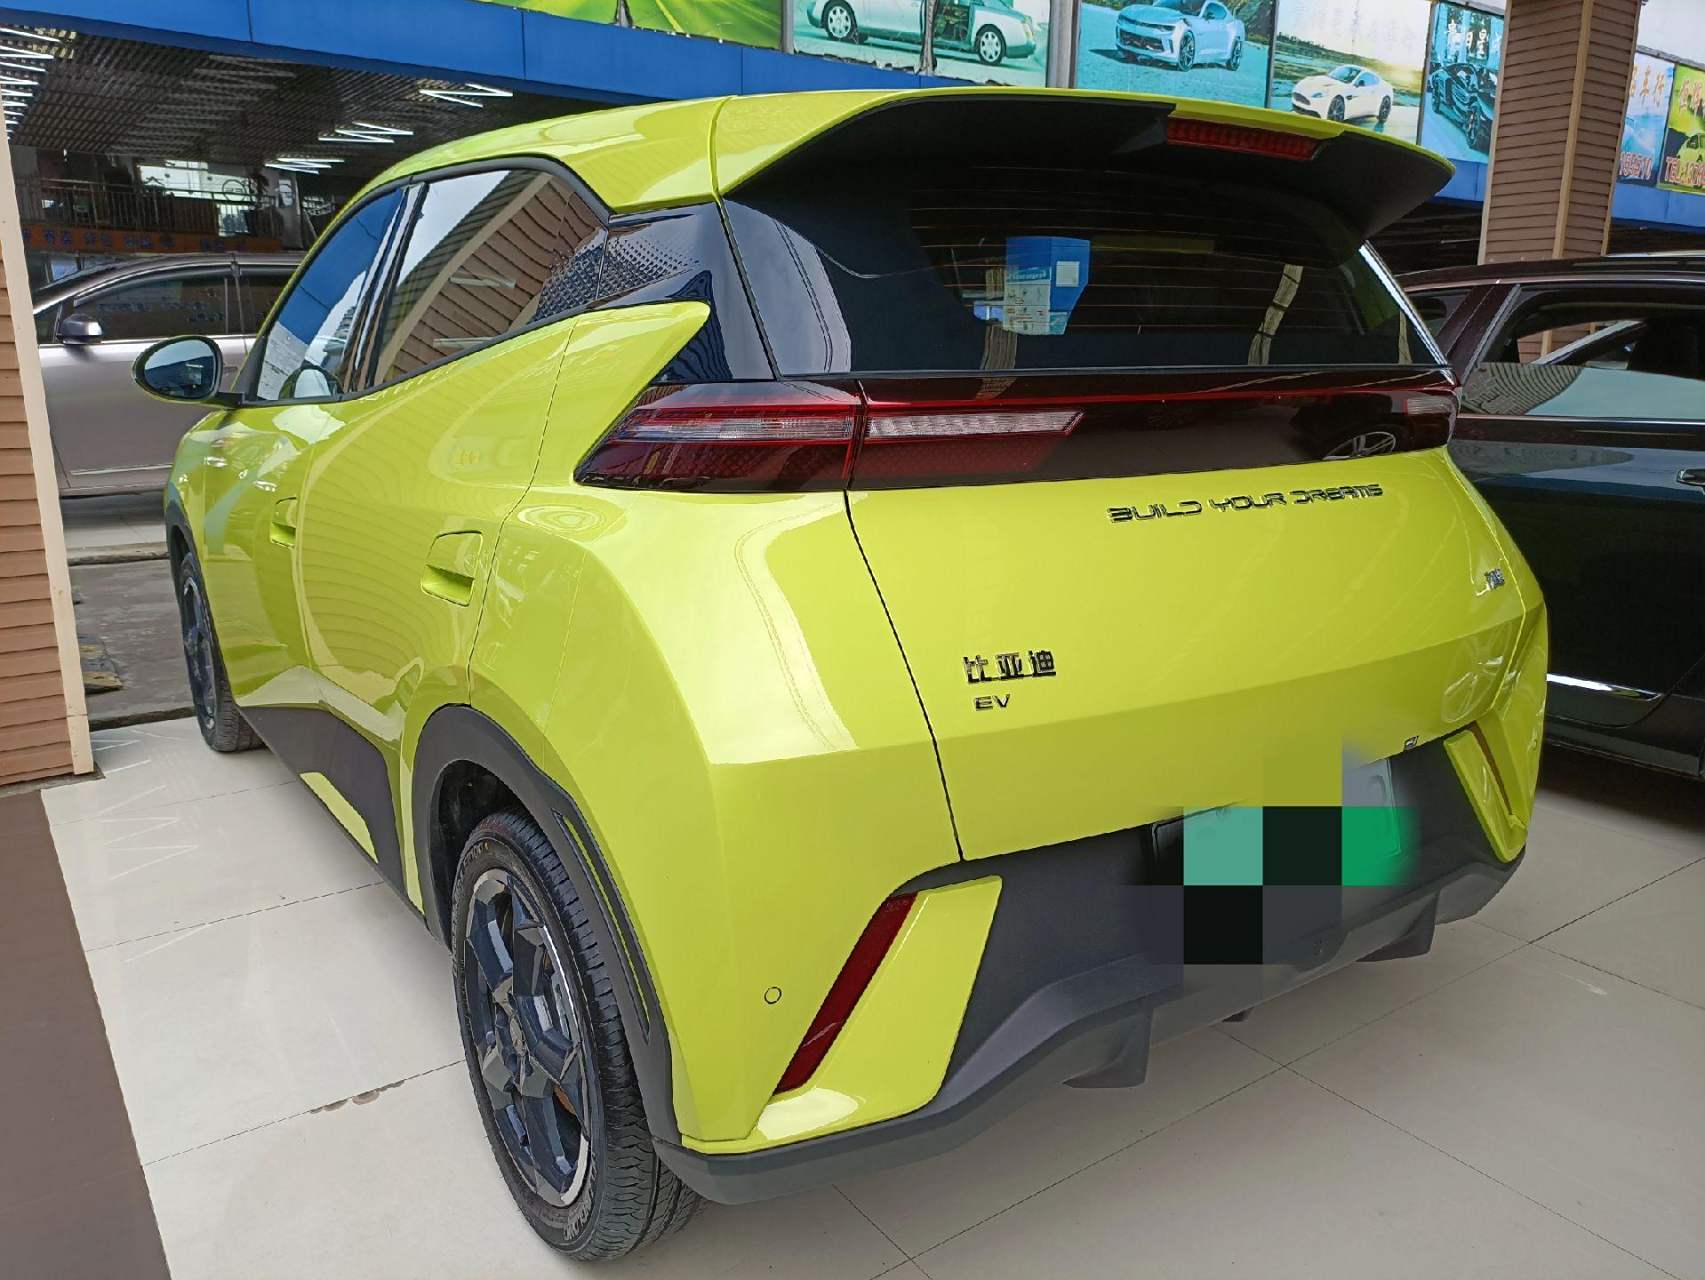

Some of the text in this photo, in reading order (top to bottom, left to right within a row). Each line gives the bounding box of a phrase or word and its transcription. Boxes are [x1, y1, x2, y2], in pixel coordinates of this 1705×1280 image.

[1107, 484, 1384, 523] BUILD YOUR DREAMS
[963, 650, 1057, 684] 比亚迪
[975, 694, 1011, 711] EV
